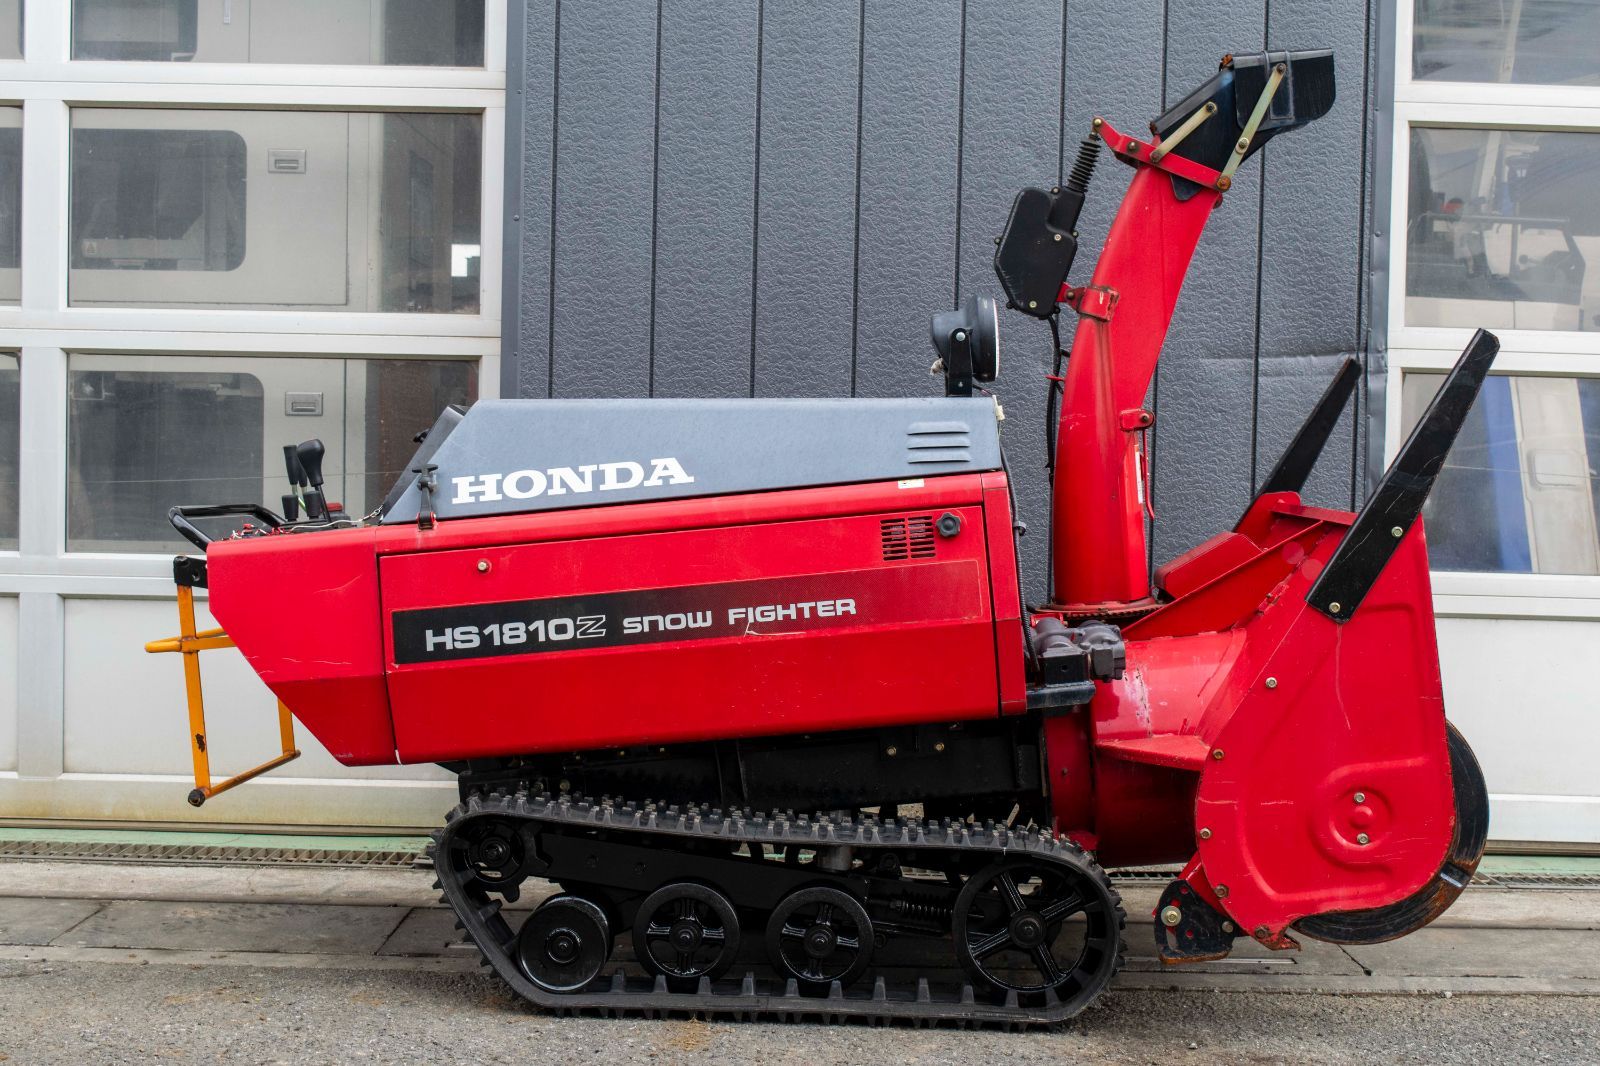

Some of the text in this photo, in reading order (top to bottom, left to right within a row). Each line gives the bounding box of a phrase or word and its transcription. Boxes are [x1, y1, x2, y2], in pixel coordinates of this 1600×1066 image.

[451, 457, 695, 505] HONDA
[425, 614, 607, 652] HS1810Z
[727, 598, 857, 626] FIGHTER
